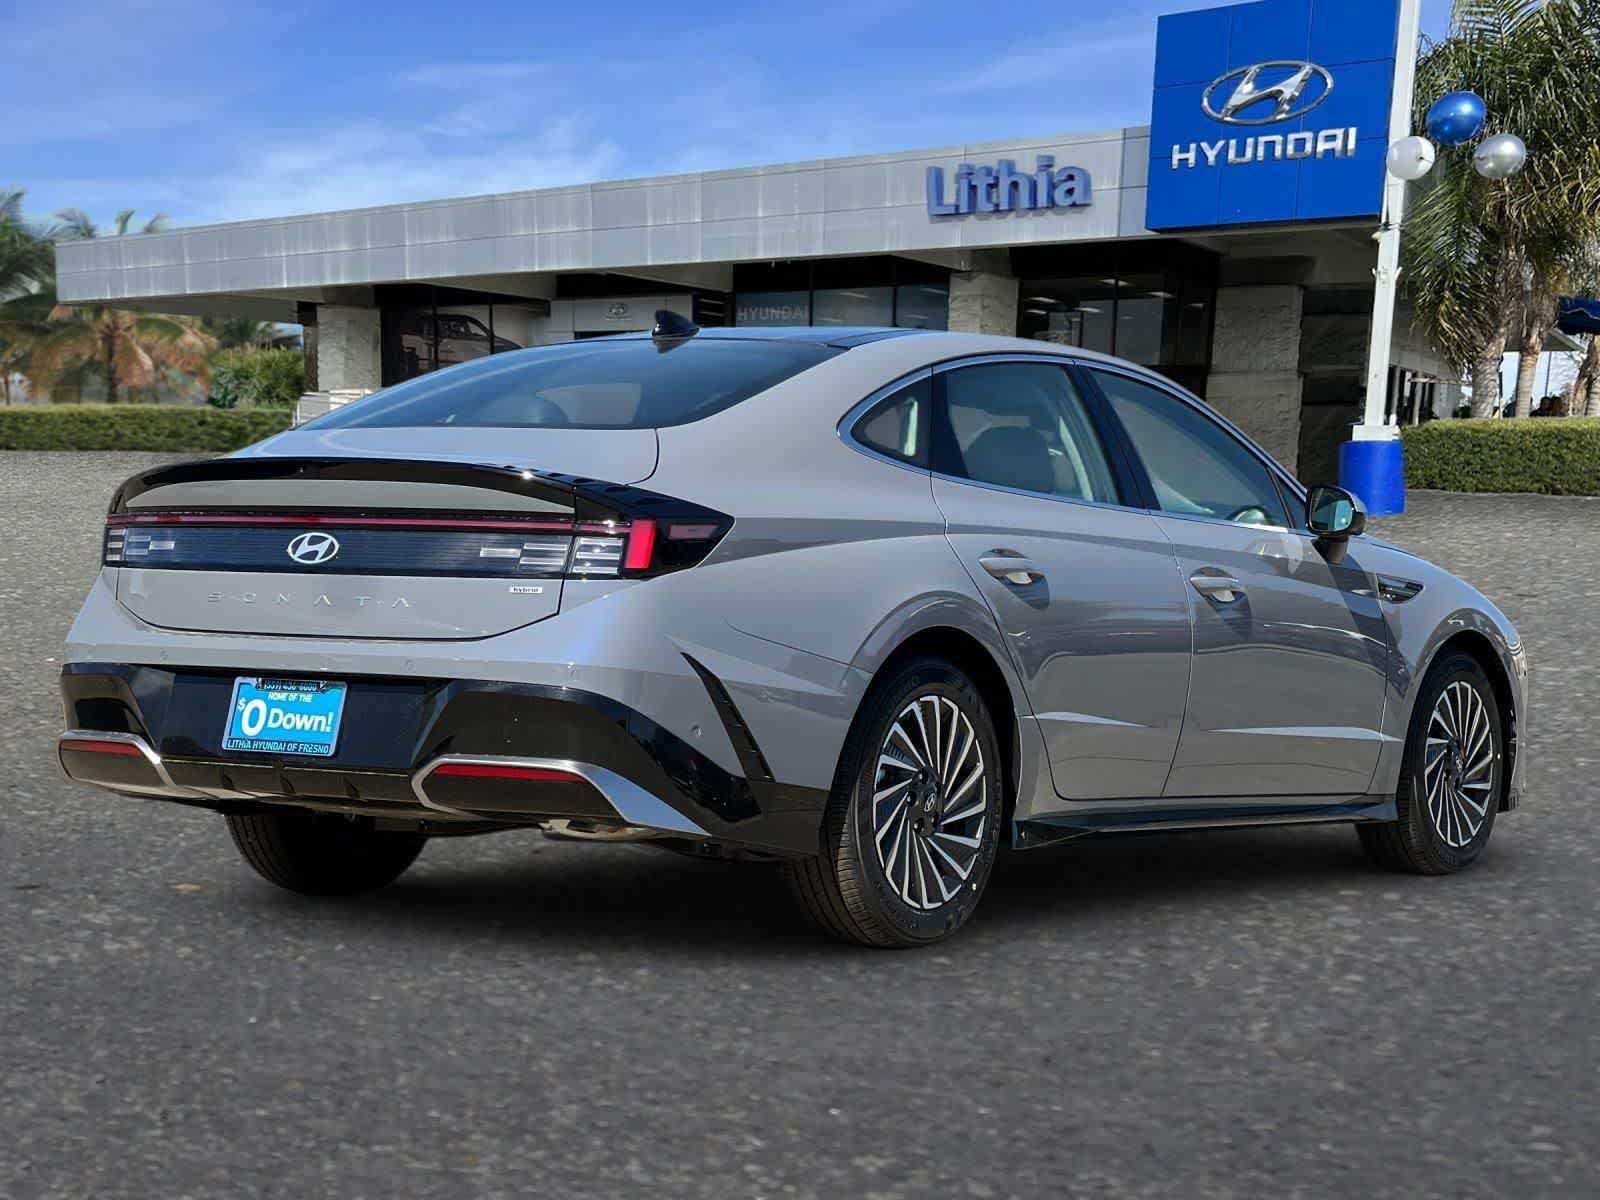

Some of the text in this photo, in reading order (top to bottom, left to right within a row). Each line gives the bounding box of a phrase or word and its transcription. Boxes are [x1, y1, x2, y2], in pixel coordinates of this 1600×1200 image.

[1171, 127, 1358, 169] HYUNDAI
[926, 155, 1092, 218] Lithia
[737, 304, 809, 321] HYUNDAI
[207, 592, 411, 608] SONATA
[288, 693, 298, 702] OF
[298, 693, 313, 703] THE
[267, 707, 334, 733] Down!
[227, 739, 329, 754] LITHIA HYUNDAI OF FRESNO
